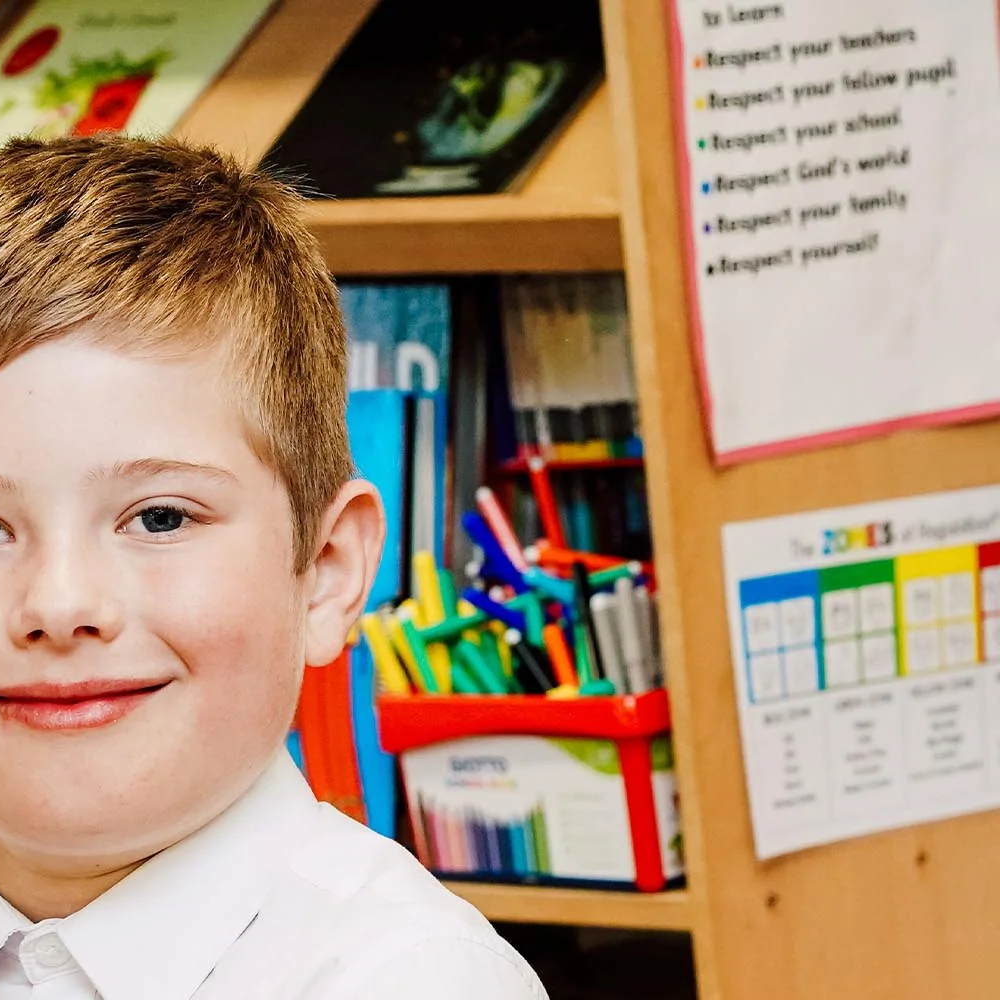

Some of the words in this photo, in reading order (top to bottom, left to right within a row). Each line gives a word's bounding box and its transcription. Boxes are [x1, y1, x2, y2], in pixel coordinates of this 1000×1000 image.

[703, 10, 721, 27] to
[727, 3, 784, 22] learn
[706, 44, 781, 71] Respect
[791, 39, 831, 64] your
[840, 27, 915, 51] teachers
[709, 84, 783, 113] Respect
[793, 80, 834, 104] your
[712, 126, 786, 154] Respect
[796, 121, 836, 146] your
[845, 106, 902, 133] school
[716, 167, 789, 195] Respect
[798, 157, 849, 180] God's
[857, 146, 910, 171] world
[717, 207, 791, 235] Respect
[800, 202, 840, 228] your
[849, 187, 907, 213] family
[720, 247, 792, 275] Respect
[801, 233, 879, 266] yourself
[822, 521, 893, 556] ZONES
